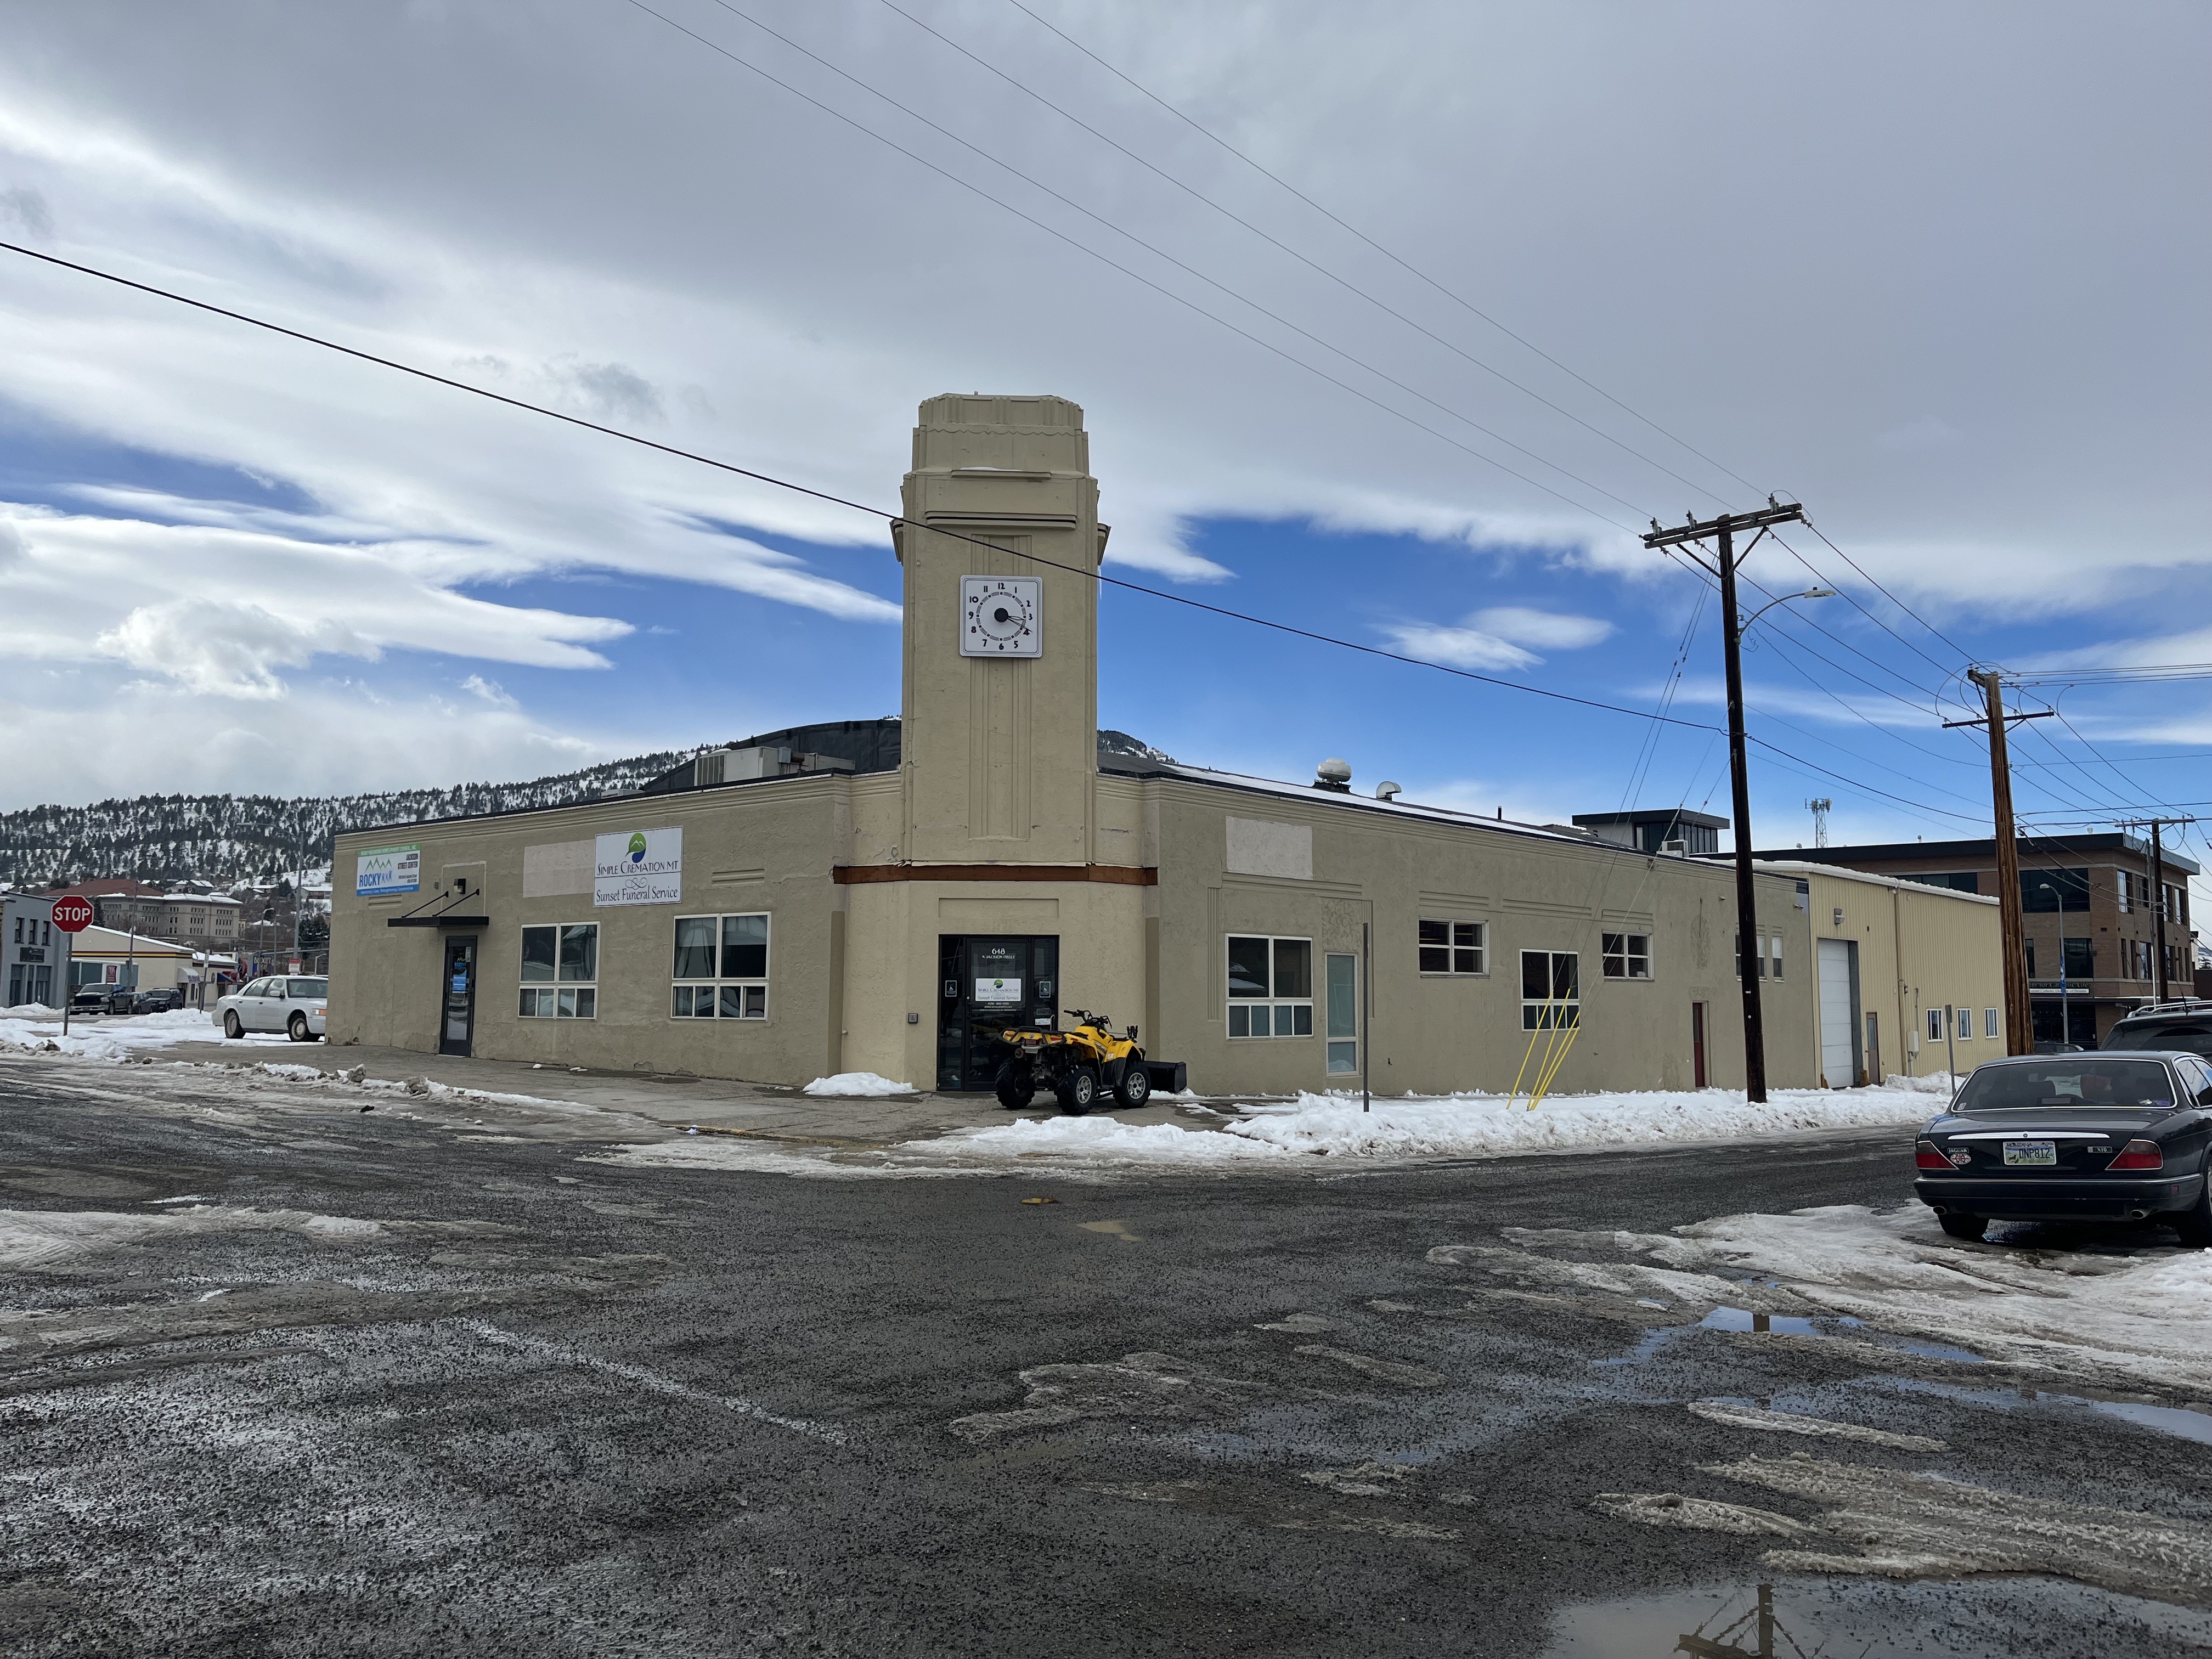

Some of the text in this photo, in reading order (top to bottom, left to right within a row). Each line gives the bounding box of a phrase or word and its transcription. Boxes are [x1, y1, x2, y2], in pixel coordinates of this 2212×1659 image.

[968, 611, 974, 619] 9
[982, 639, 988, 647] 7
[1013, 640, 1019, 649] 5
[620, 861, 665, 874] CREMATION
[667, 861, 678, 870] MT
[359, 873, 381, 887] ROCKY
[596, 885, 678, 902] Sunset Funeral Service
[54, 907, 91, 921] STOP
[2018, 1148, 2051, 1159] DNP812
